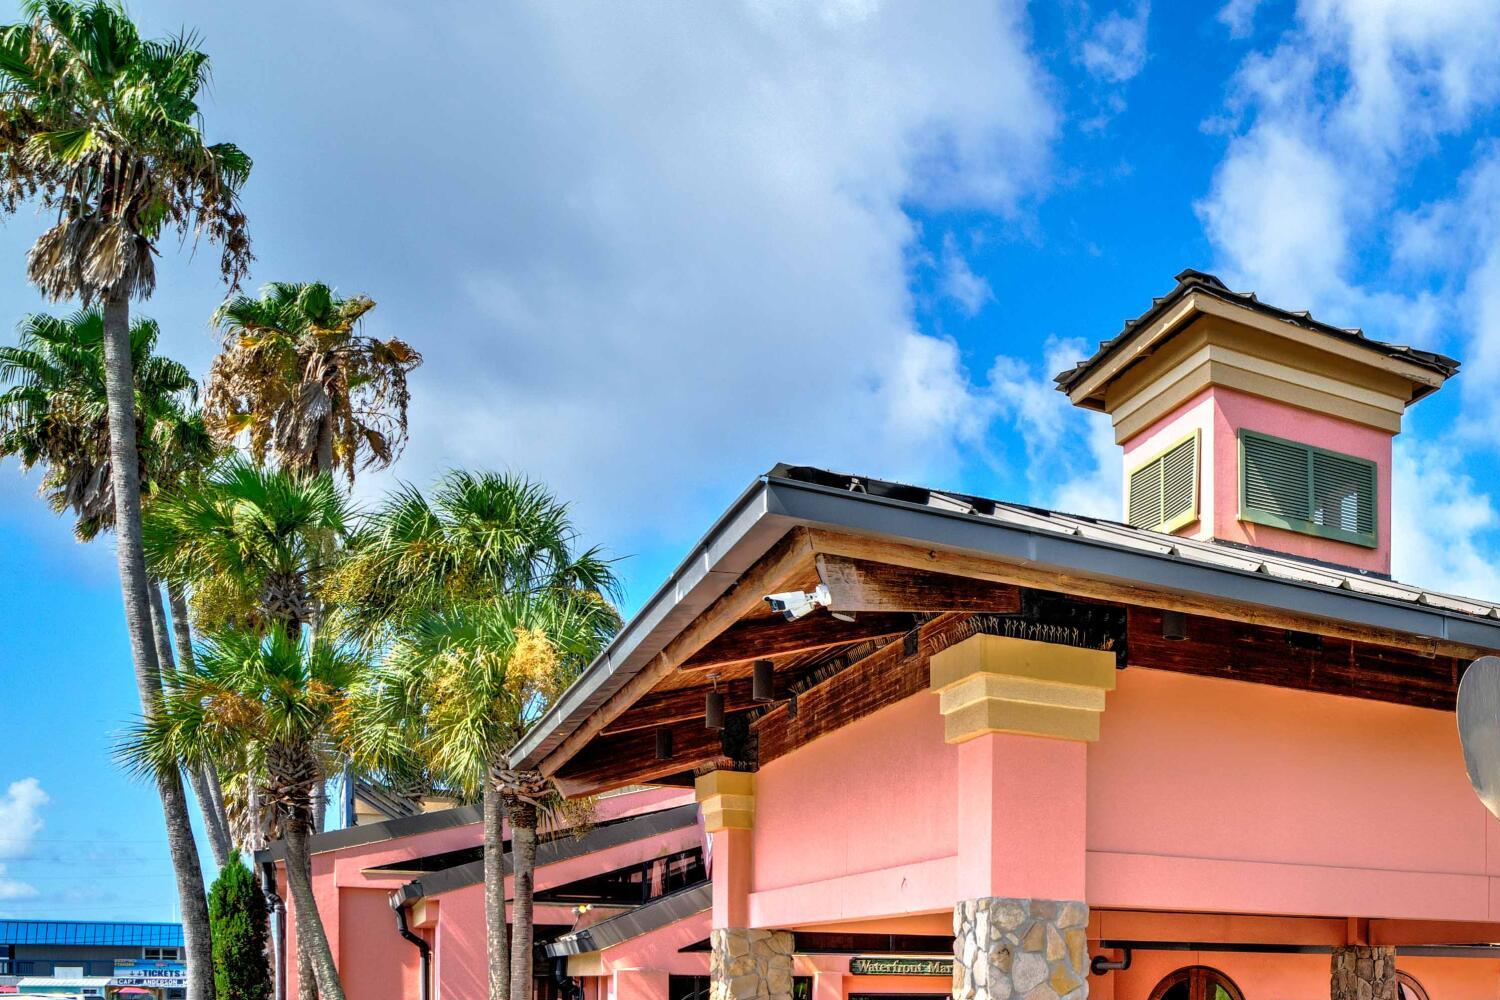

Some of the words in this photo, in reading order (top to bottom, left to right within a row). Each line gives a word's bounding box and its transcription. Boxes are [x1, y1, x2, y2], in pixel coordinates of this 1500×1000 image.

[857, 959, 922, 974] Waterfront
[928, 961, 953, 974] Mar
[143, 969, 180, 977] TICKETS
